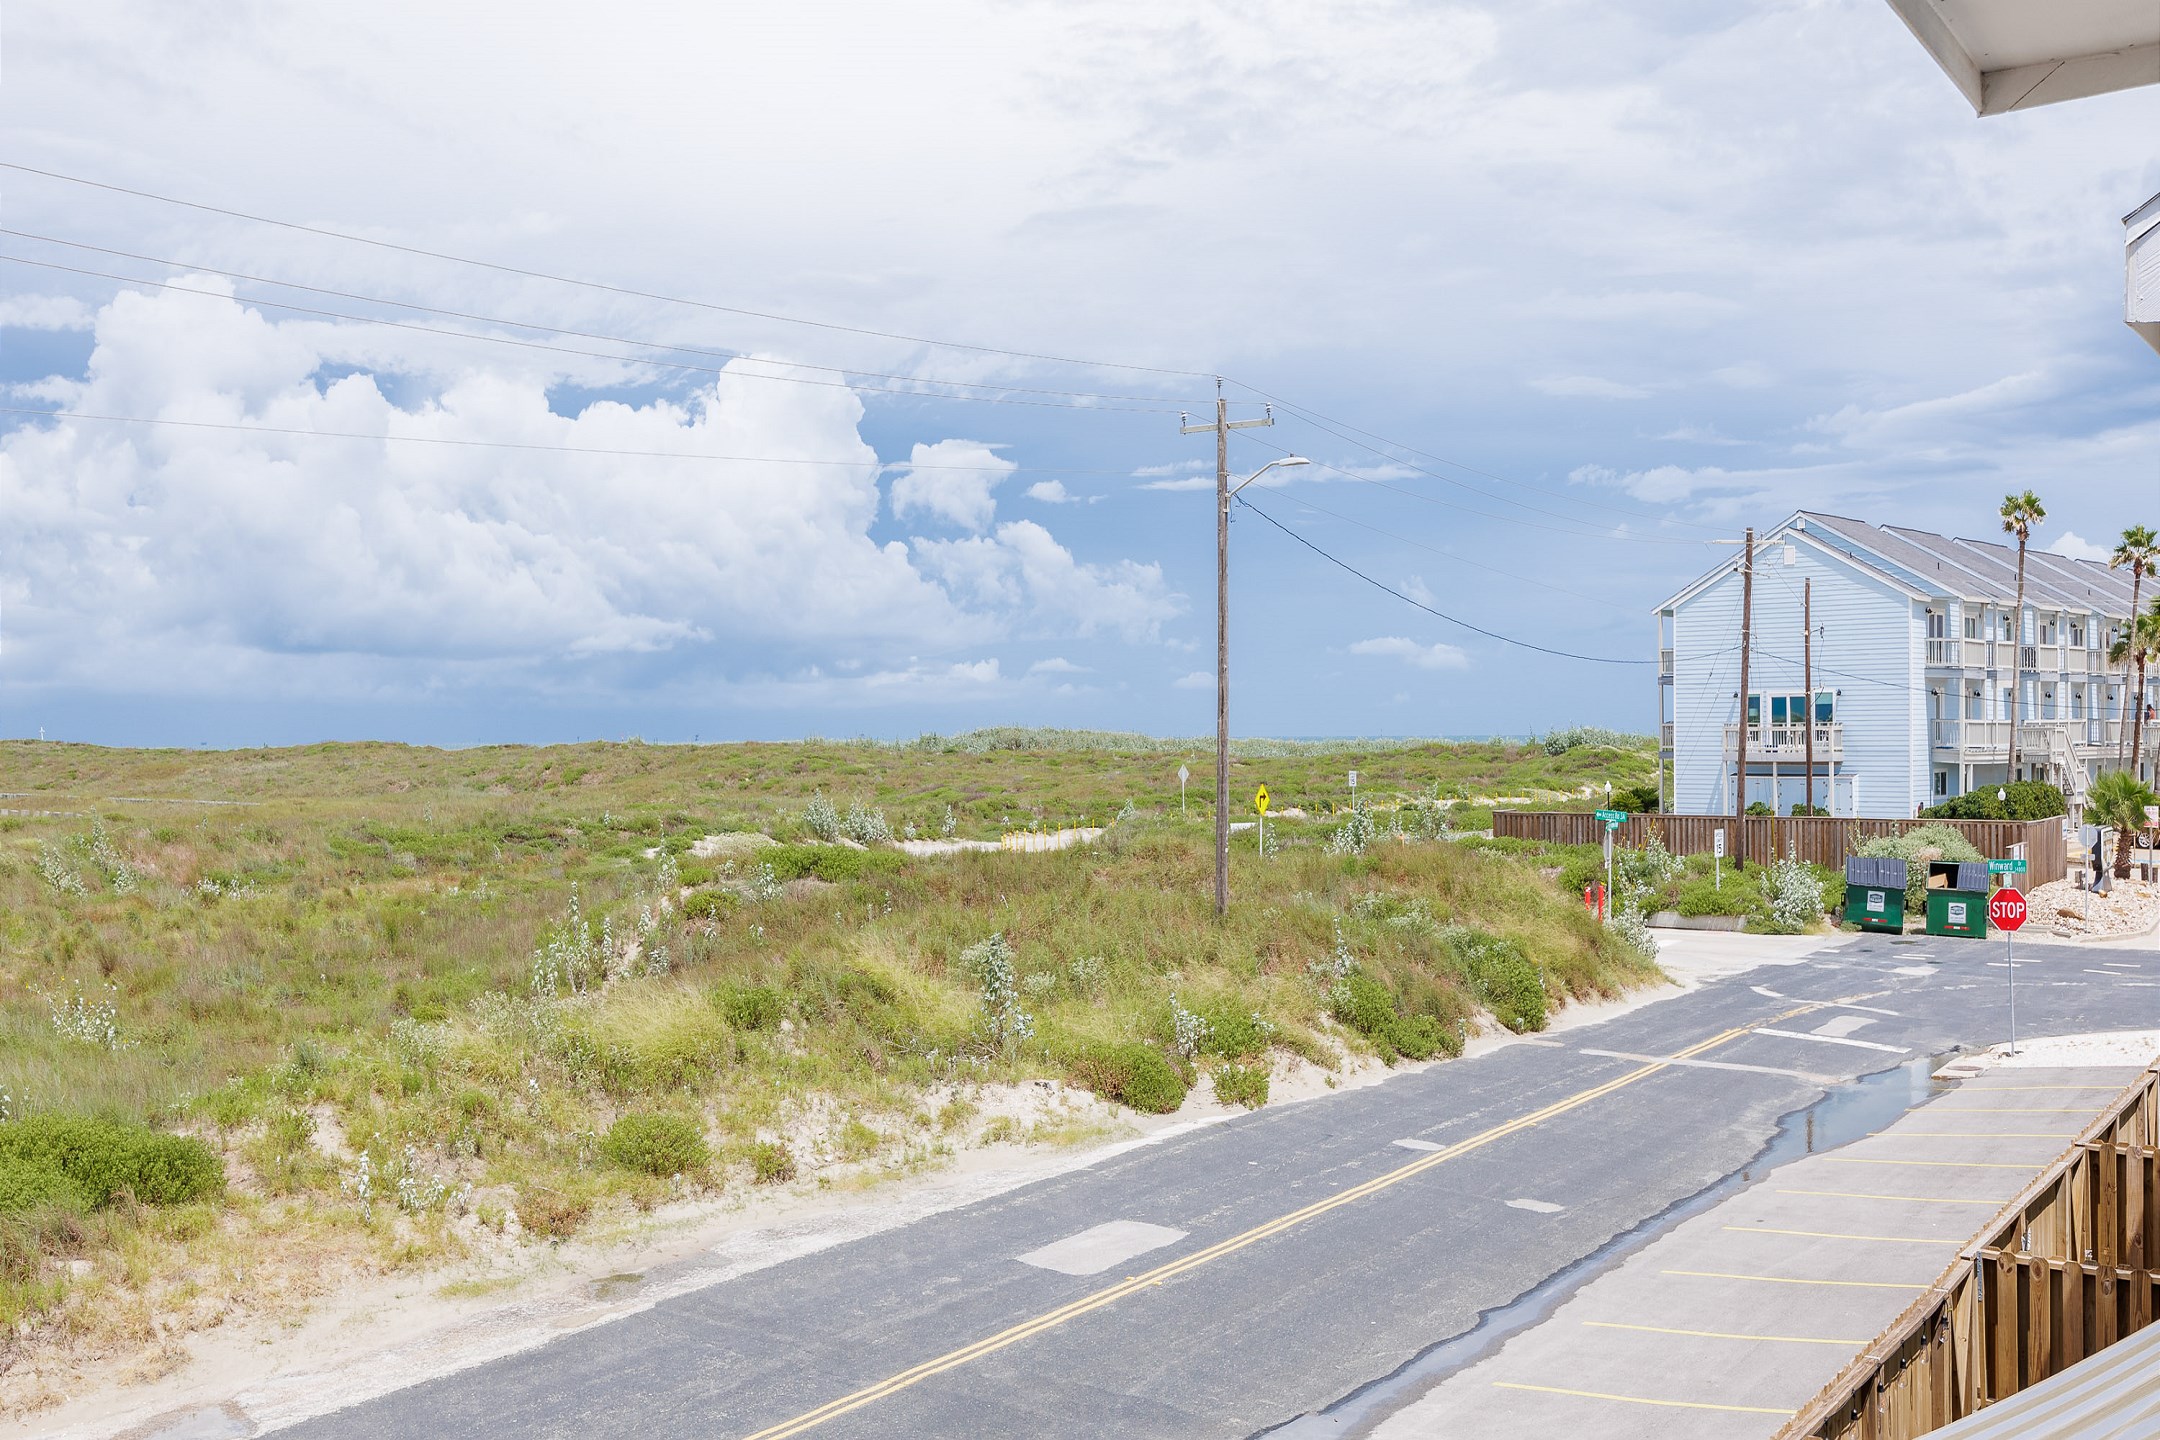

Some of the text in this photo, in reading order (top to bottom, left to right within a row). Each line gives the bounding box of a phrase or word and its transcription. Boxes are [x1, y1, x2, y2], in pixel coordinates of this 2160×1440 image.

[1602, 811, 1614, 819] Access
[1716, 844, 1722, 853] 15
[1992, 902, 2024, 918] STOP
